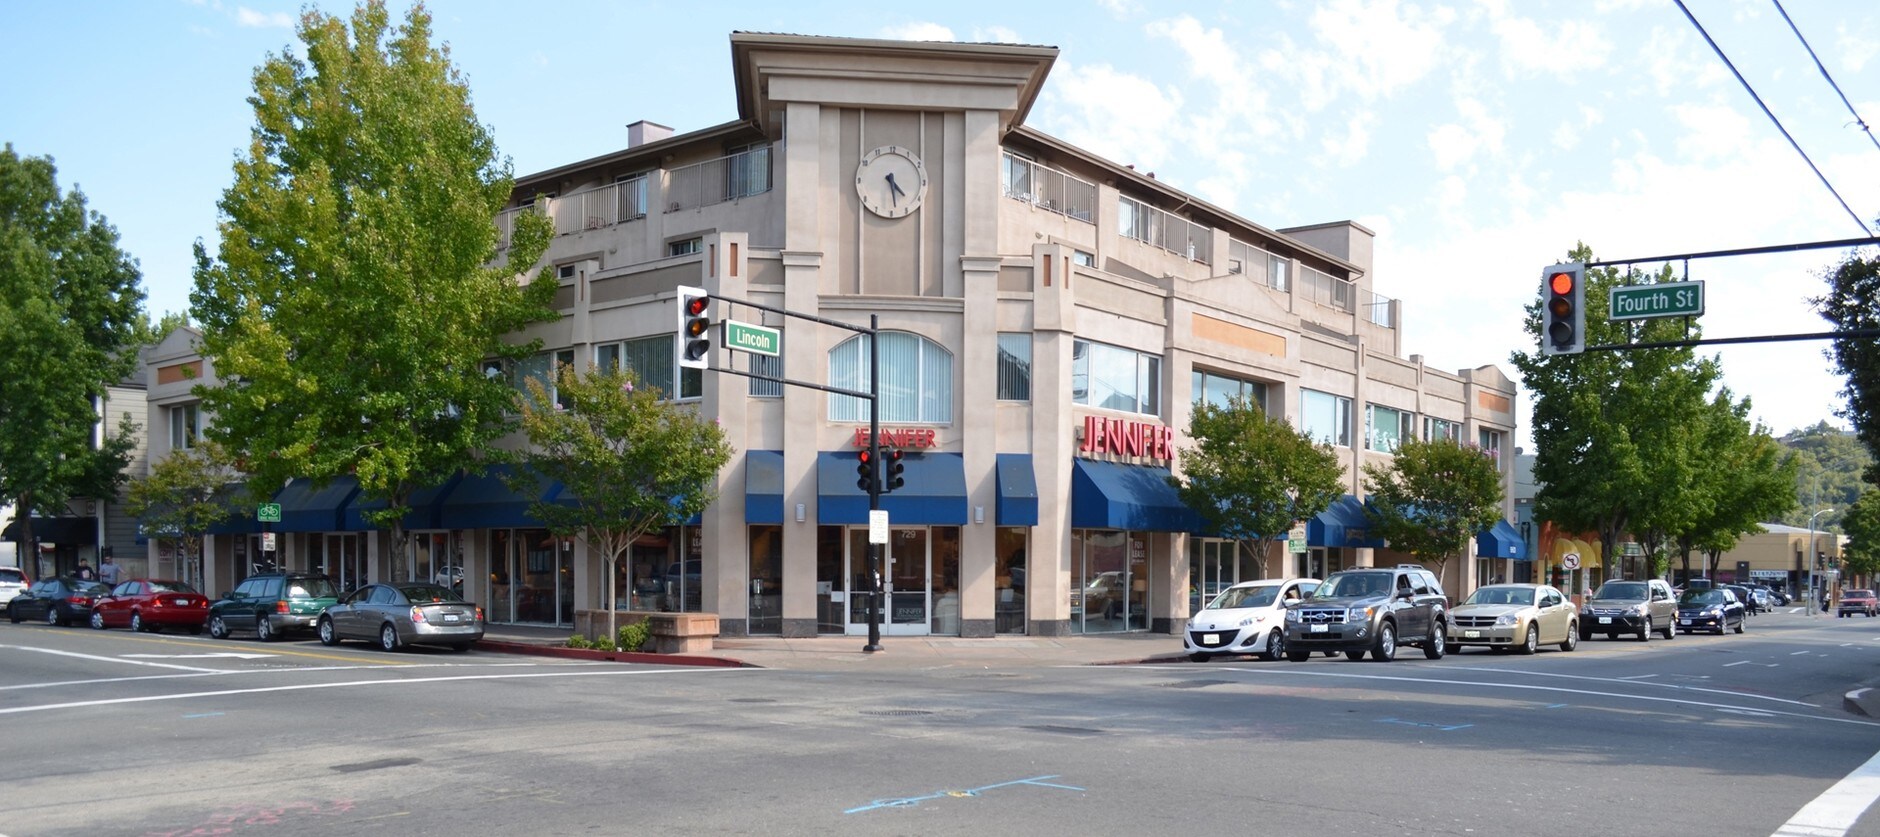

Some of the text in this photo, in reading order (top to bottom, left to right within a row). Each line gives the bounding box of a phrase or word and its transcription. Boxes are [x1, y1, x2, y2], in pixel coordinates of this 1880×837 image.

[1617, 289, 1694, 312] Fourth St
[736, 328, 770, 349] Lincoln
[1079, 415, 1176, 460] JENNIFER
[901, 530, 916, 539] 729
